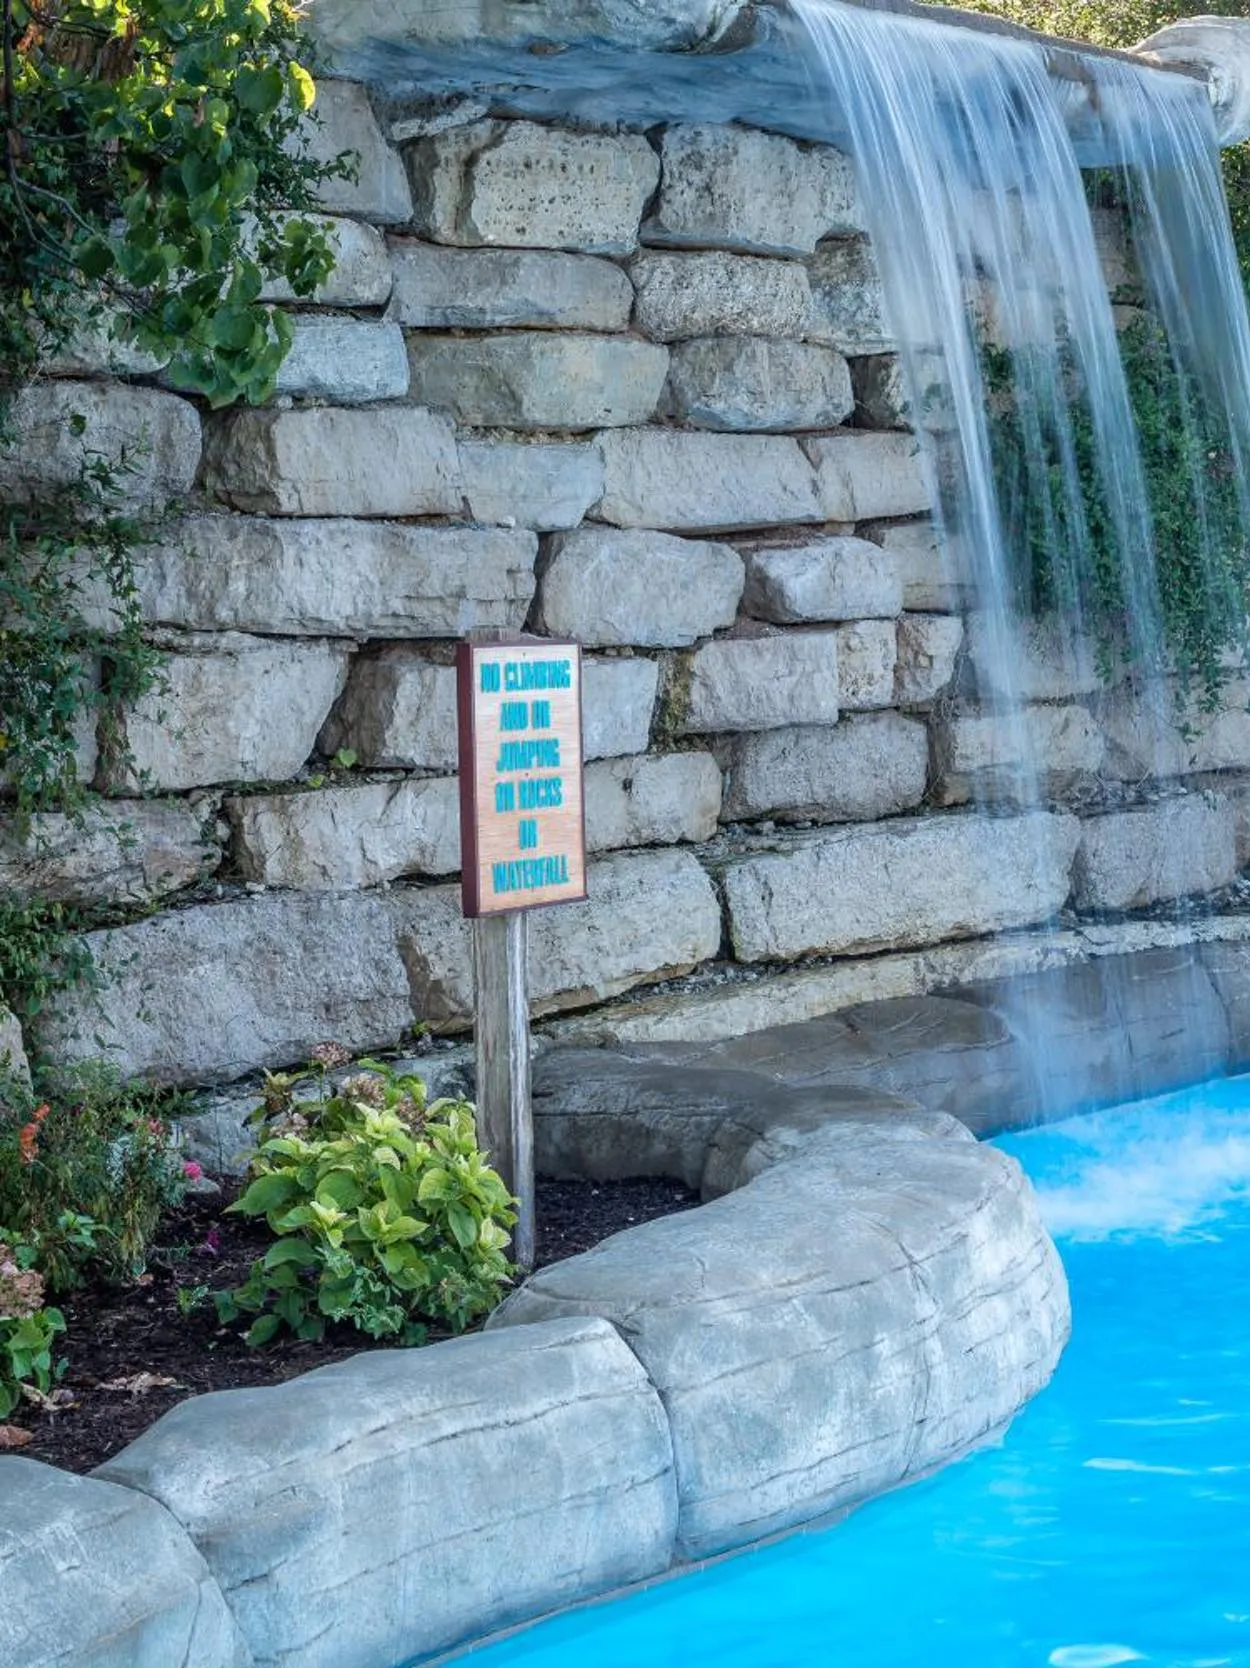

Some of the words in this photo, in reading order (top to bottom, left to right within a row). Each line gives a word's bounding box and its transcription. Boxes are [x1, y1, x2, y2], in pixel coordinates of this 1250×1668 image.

[480, 662, 501, 693] NO
[504, 659, 572, 691] CLIMBING
[496, 738, 560, 773] JUMPING
[519, 777, 563, 808] ROCKS
[492, 855, 569, 893] WATERFALL
